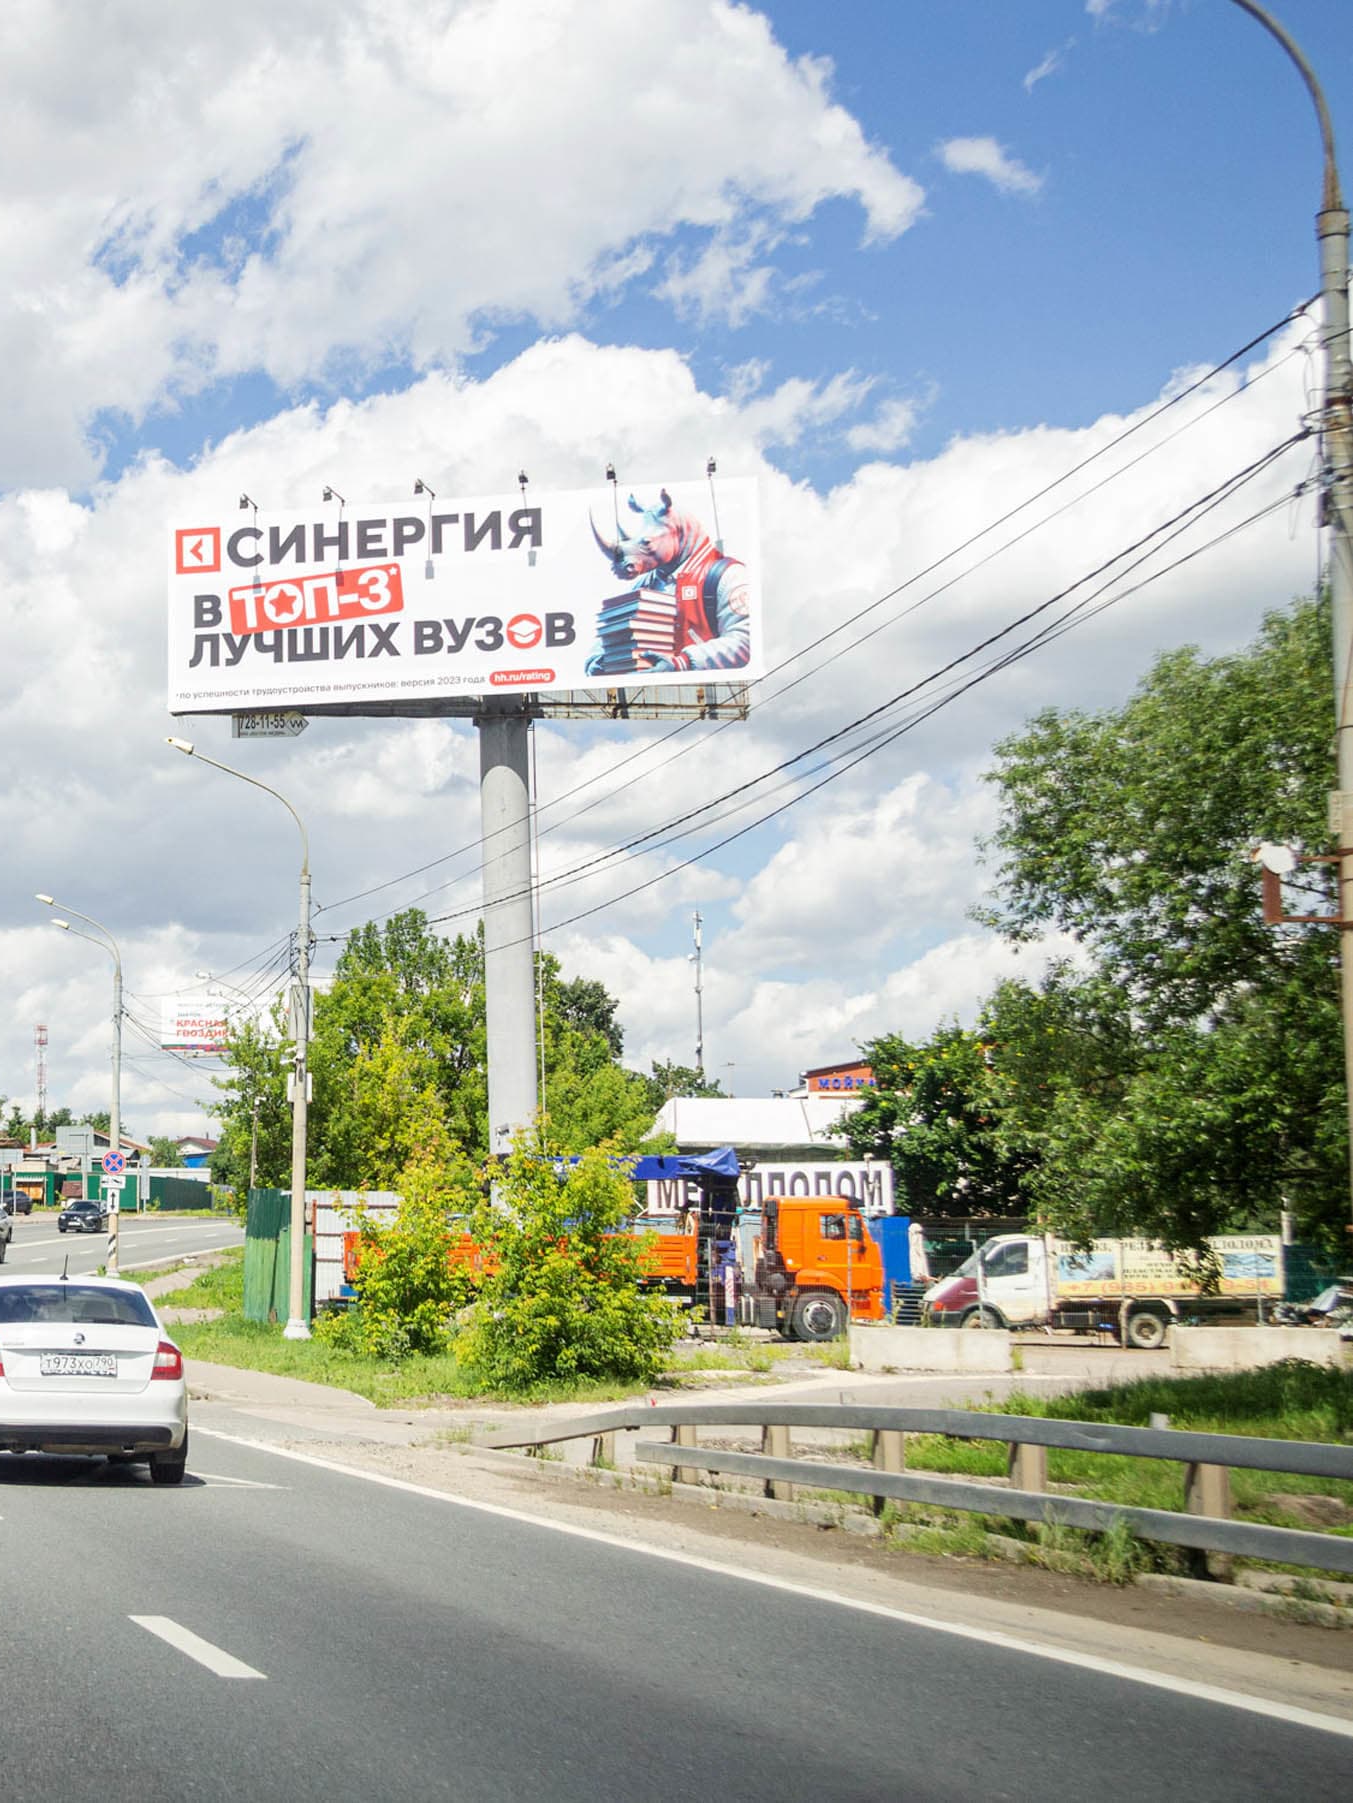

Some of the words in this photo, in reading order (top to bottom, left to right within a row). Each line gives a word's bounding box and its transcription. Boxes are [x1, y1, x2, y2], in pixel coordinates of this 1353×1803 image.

[226, 508, 542, 568] СИНЕРГИЯ
[194, 595, 222, 628] В
[189, 621, 401, 668] ЛУЧШИХ
[414, 611, 576, 655] ВУЗОВ
[193, 689, 249, 699] успешности
[252, 683, 331, 696] трудоустройства
[333, 678, 399, 692] выпускников:
[401, 678, 435, 687] версия
[437, 677, 461, 685] 2023
[463, 676, 485, 684] года
[494, 672, 551, 682] hh.ru/rating
